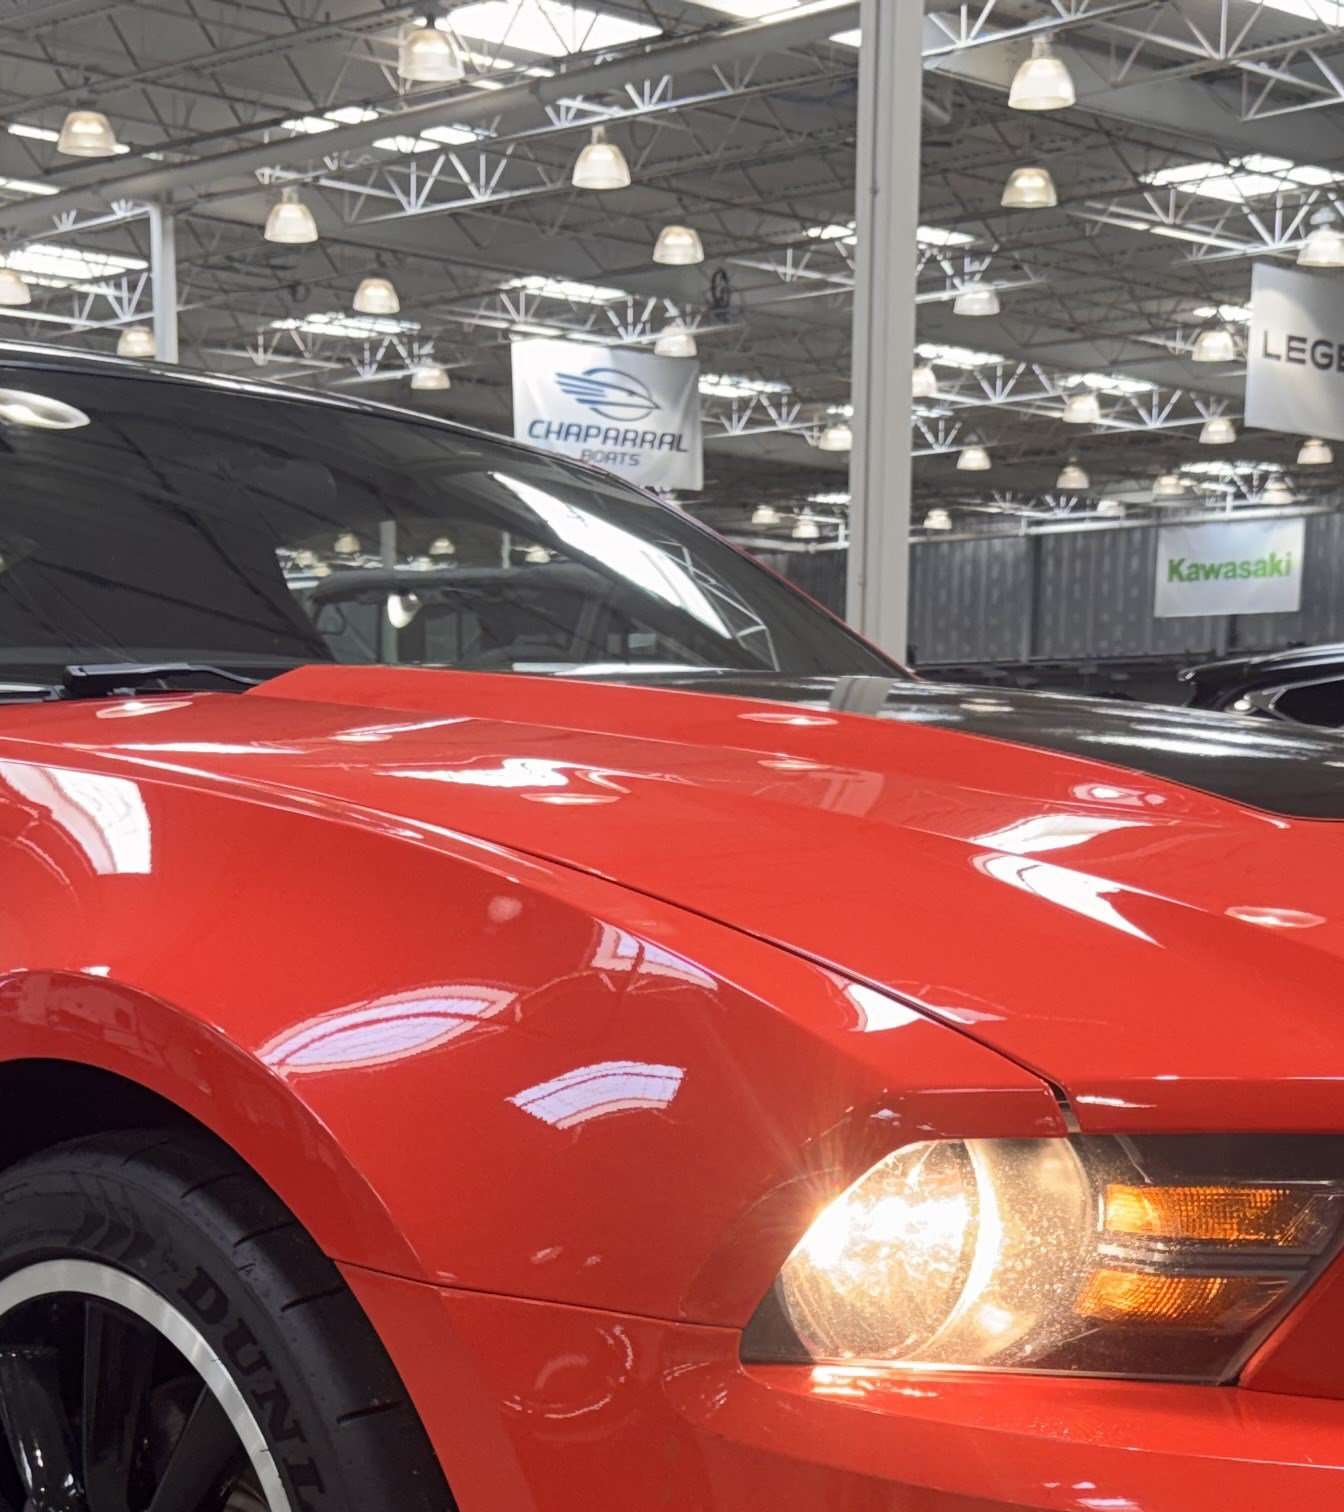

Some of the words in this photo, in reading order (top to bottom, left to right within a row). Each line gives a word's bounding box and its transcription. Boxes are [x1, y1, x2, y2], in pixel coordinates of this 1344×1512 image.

[528, 418, 689, 453] CHAPARRAL
[580, 450, 641, 467] BOATS
[1167, 551, 1294, 583] Kawasaki
